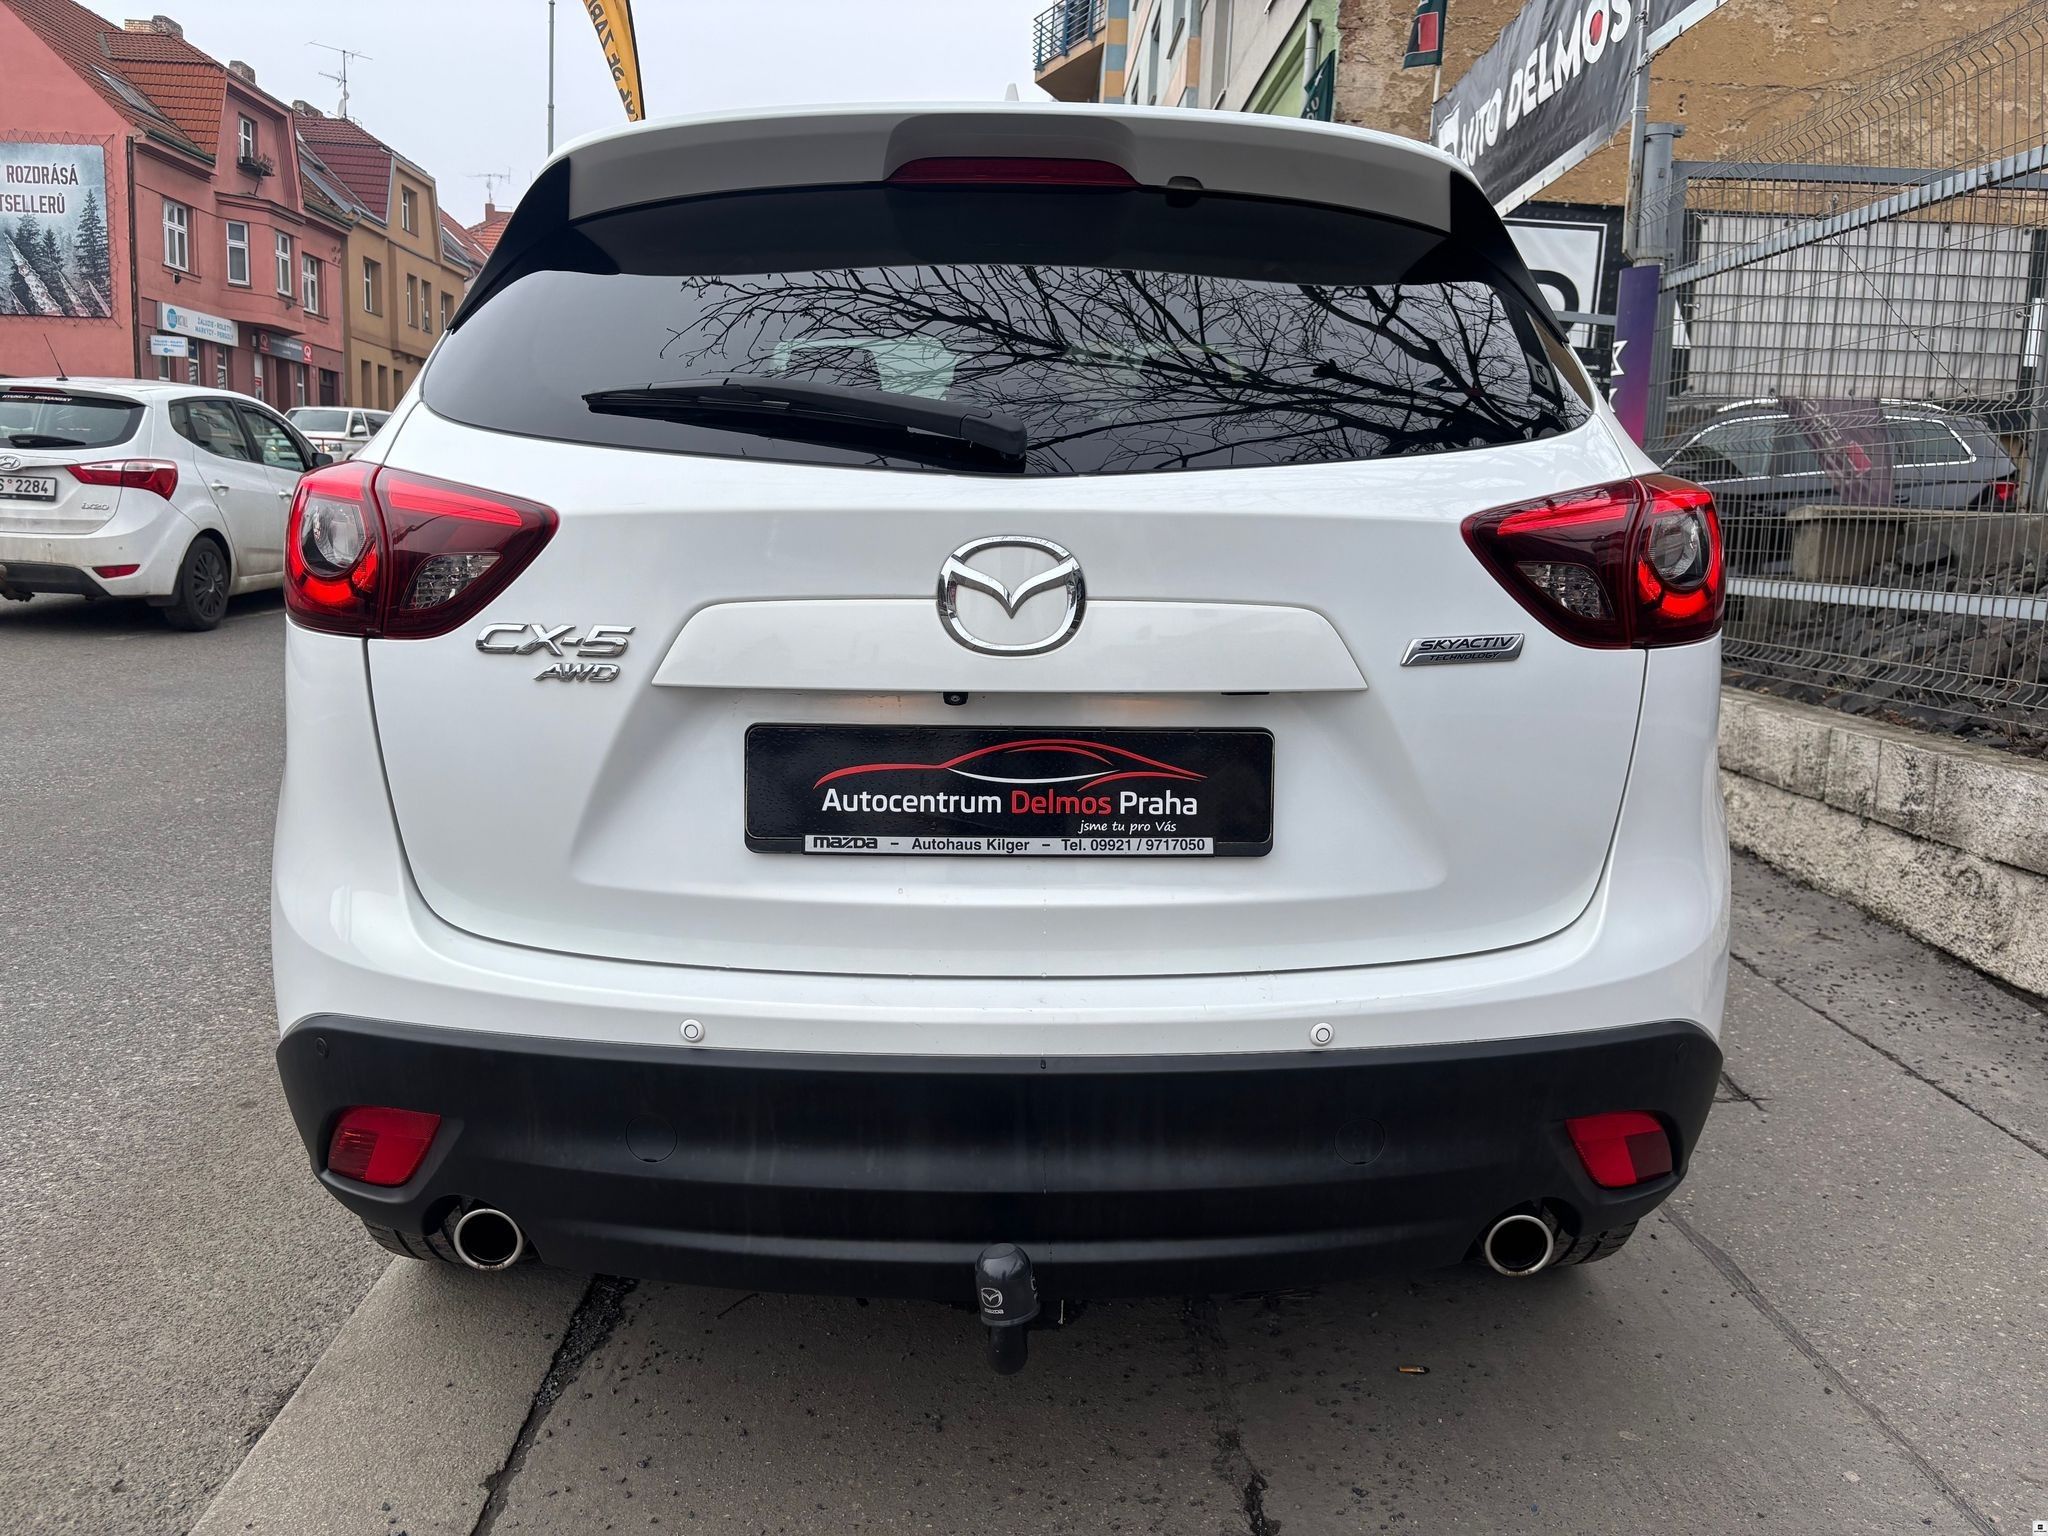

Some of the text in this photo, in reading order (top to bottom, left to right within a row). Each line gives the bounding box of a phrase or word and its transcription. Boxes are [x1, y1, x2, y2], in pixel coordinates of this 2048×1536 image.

[1461, 0, 1631, 167] AUTO DELMOS
[6, 163, 79, 185] ROZDRÁSÁ
[15, 479, 49, 494] 2284
[475, 623, 637, 658] CX-5
[1418, 637, 1514, 650] SKYACTIV
[1429, 652, 1501, 662] TECHNOLOGY
[533, 662, 621, 683] AWD
[821, 788, 1198, 816] Autocentrum Delmos Praha
[1077, 819, 1178, 836] jsme tu pro Vás
[911, 838, 982, 851] Autohaus
[986, 838, 1030, 854] Kilger
[1061, 838, 1086, 851] Tel.
[1090, 838, 1132, 852] 09921
[1145, 838, 1206, 852] 9717050
